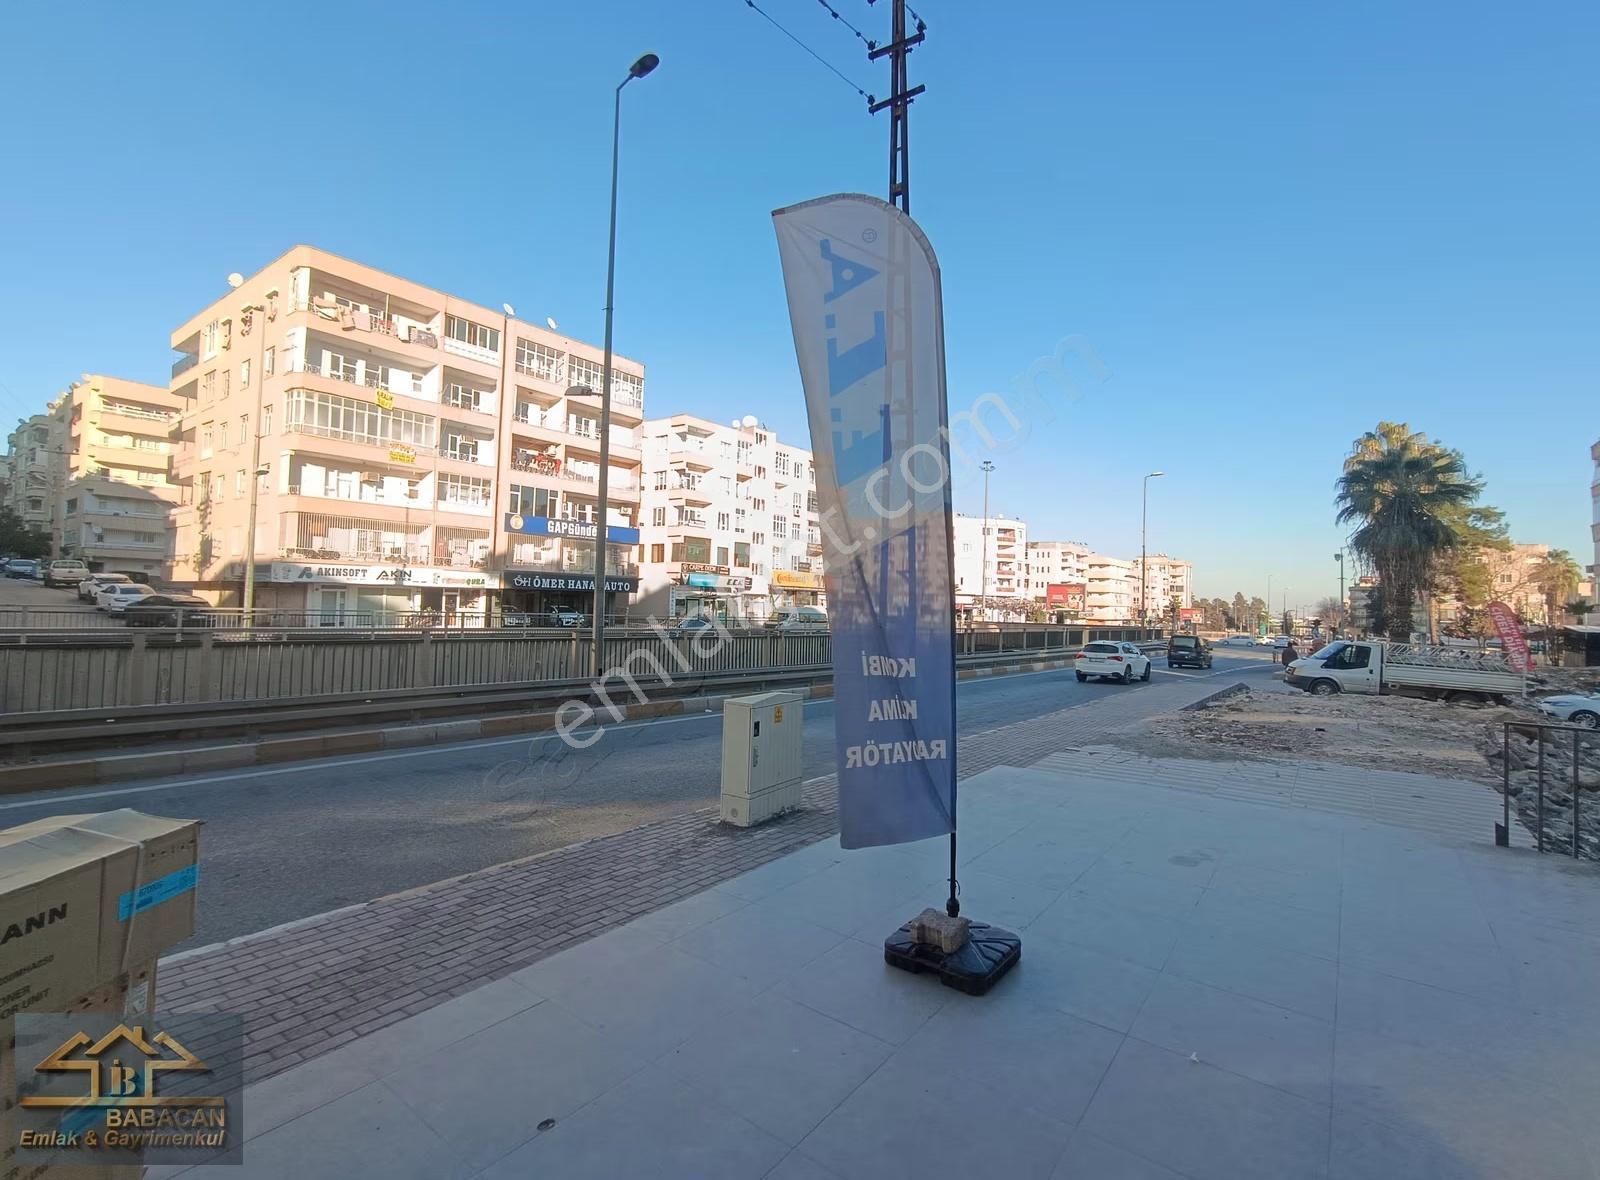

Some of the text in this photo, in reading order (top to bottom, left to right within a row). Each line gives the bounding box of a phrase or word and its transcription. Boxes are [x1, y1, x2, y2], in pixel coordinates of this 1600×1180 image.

[547, 520, 609, 539] GAPGündei
[316, 567, 368, 578] AKINSOFT
[376, 569, 412, 580] AKIN
[533, 576, 565, 589] ÖMER
[604, 581, 631, 591] AUTO
